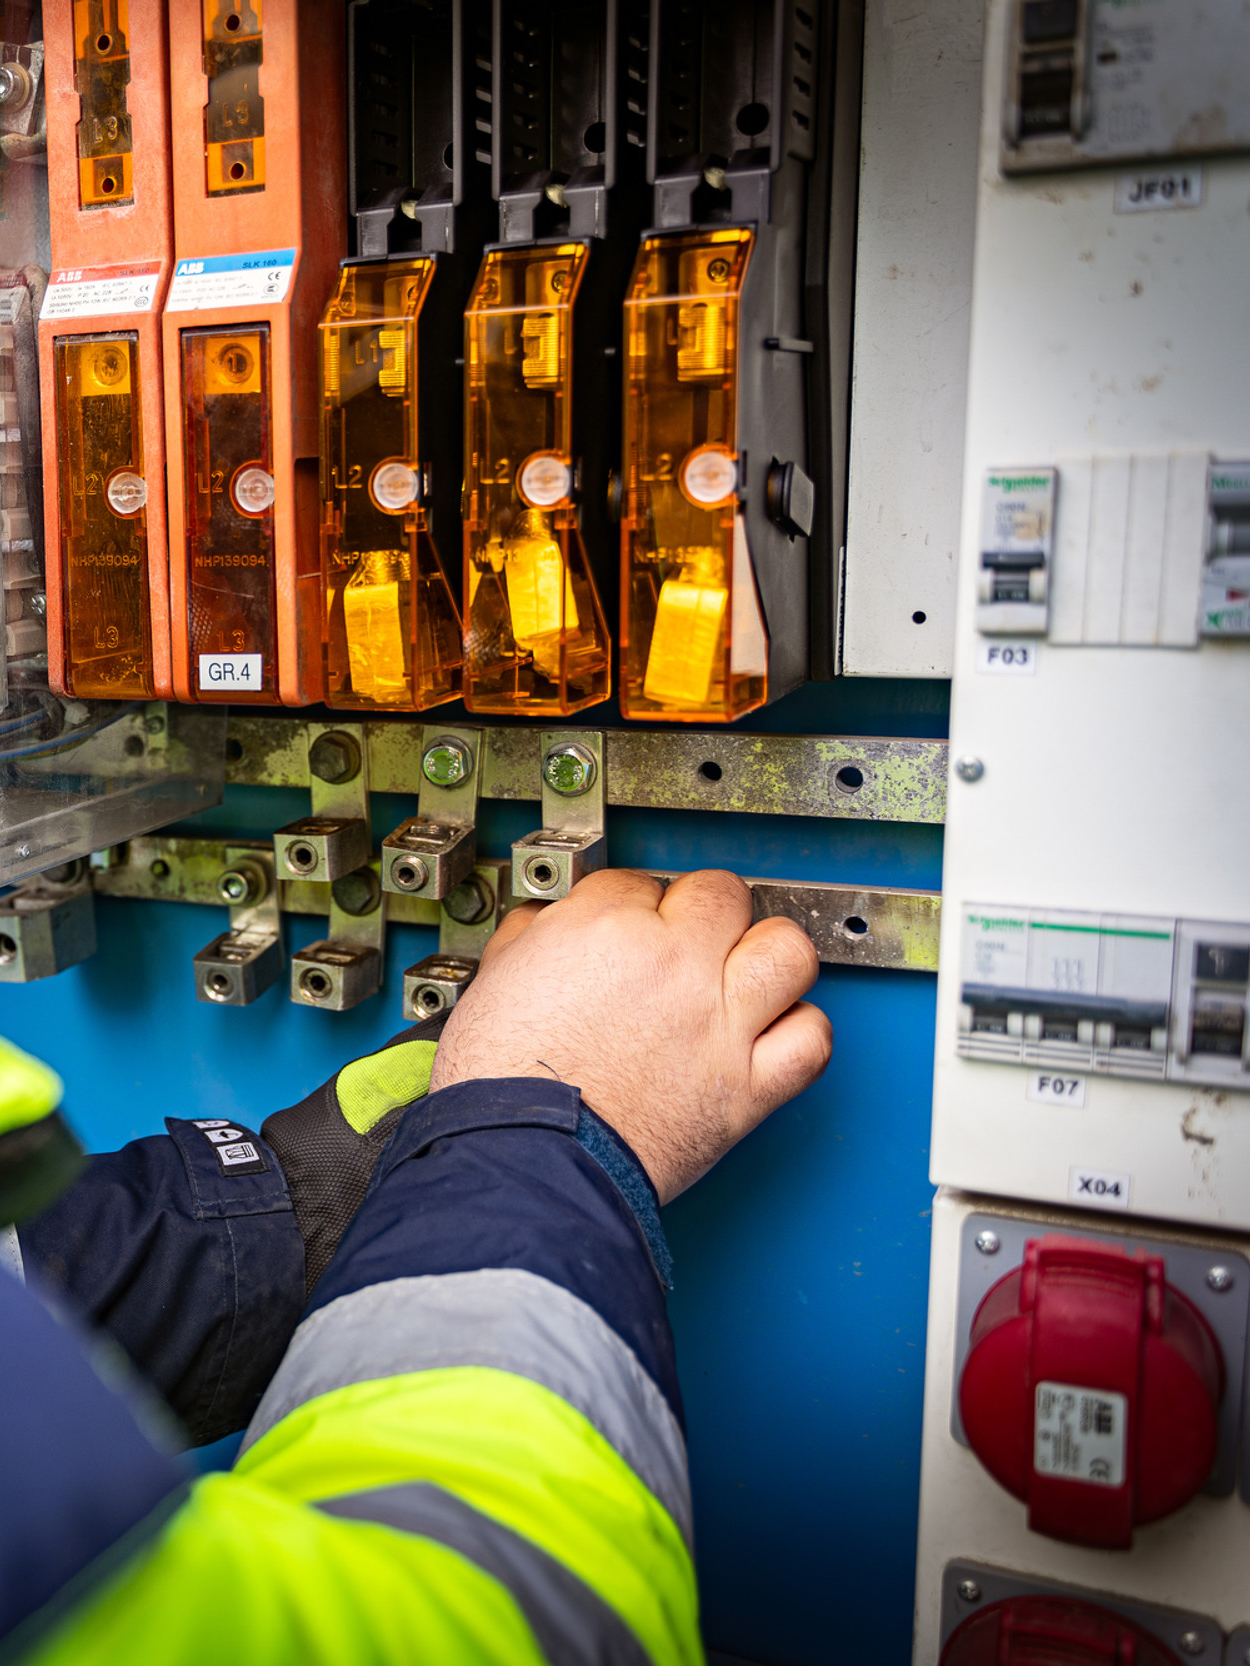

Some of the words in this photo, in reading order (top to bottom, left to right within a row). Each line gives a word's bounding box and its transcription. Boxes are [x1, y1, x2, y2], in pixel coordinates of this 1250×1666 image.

[1128, 176, 1191, 204] JF01
[177, 262, 204, 276] ABB
[242, 260, 260, 269] SLK
[263, 259, 278, 267] 160
[56, 270, 84, 283] ABB
[72, 472, 99, 496] L2
[195, 469, 225, 494] L2
[93, 625, 119, 649] L3
[217, 629, 245, 652] L3
[987, 647, 1028, 666] F03
[207, 662, 251, 682] GR.4
[1037, 1075, 1079, 1096] F07
[1078, 1175, 1121, 1198] X04
